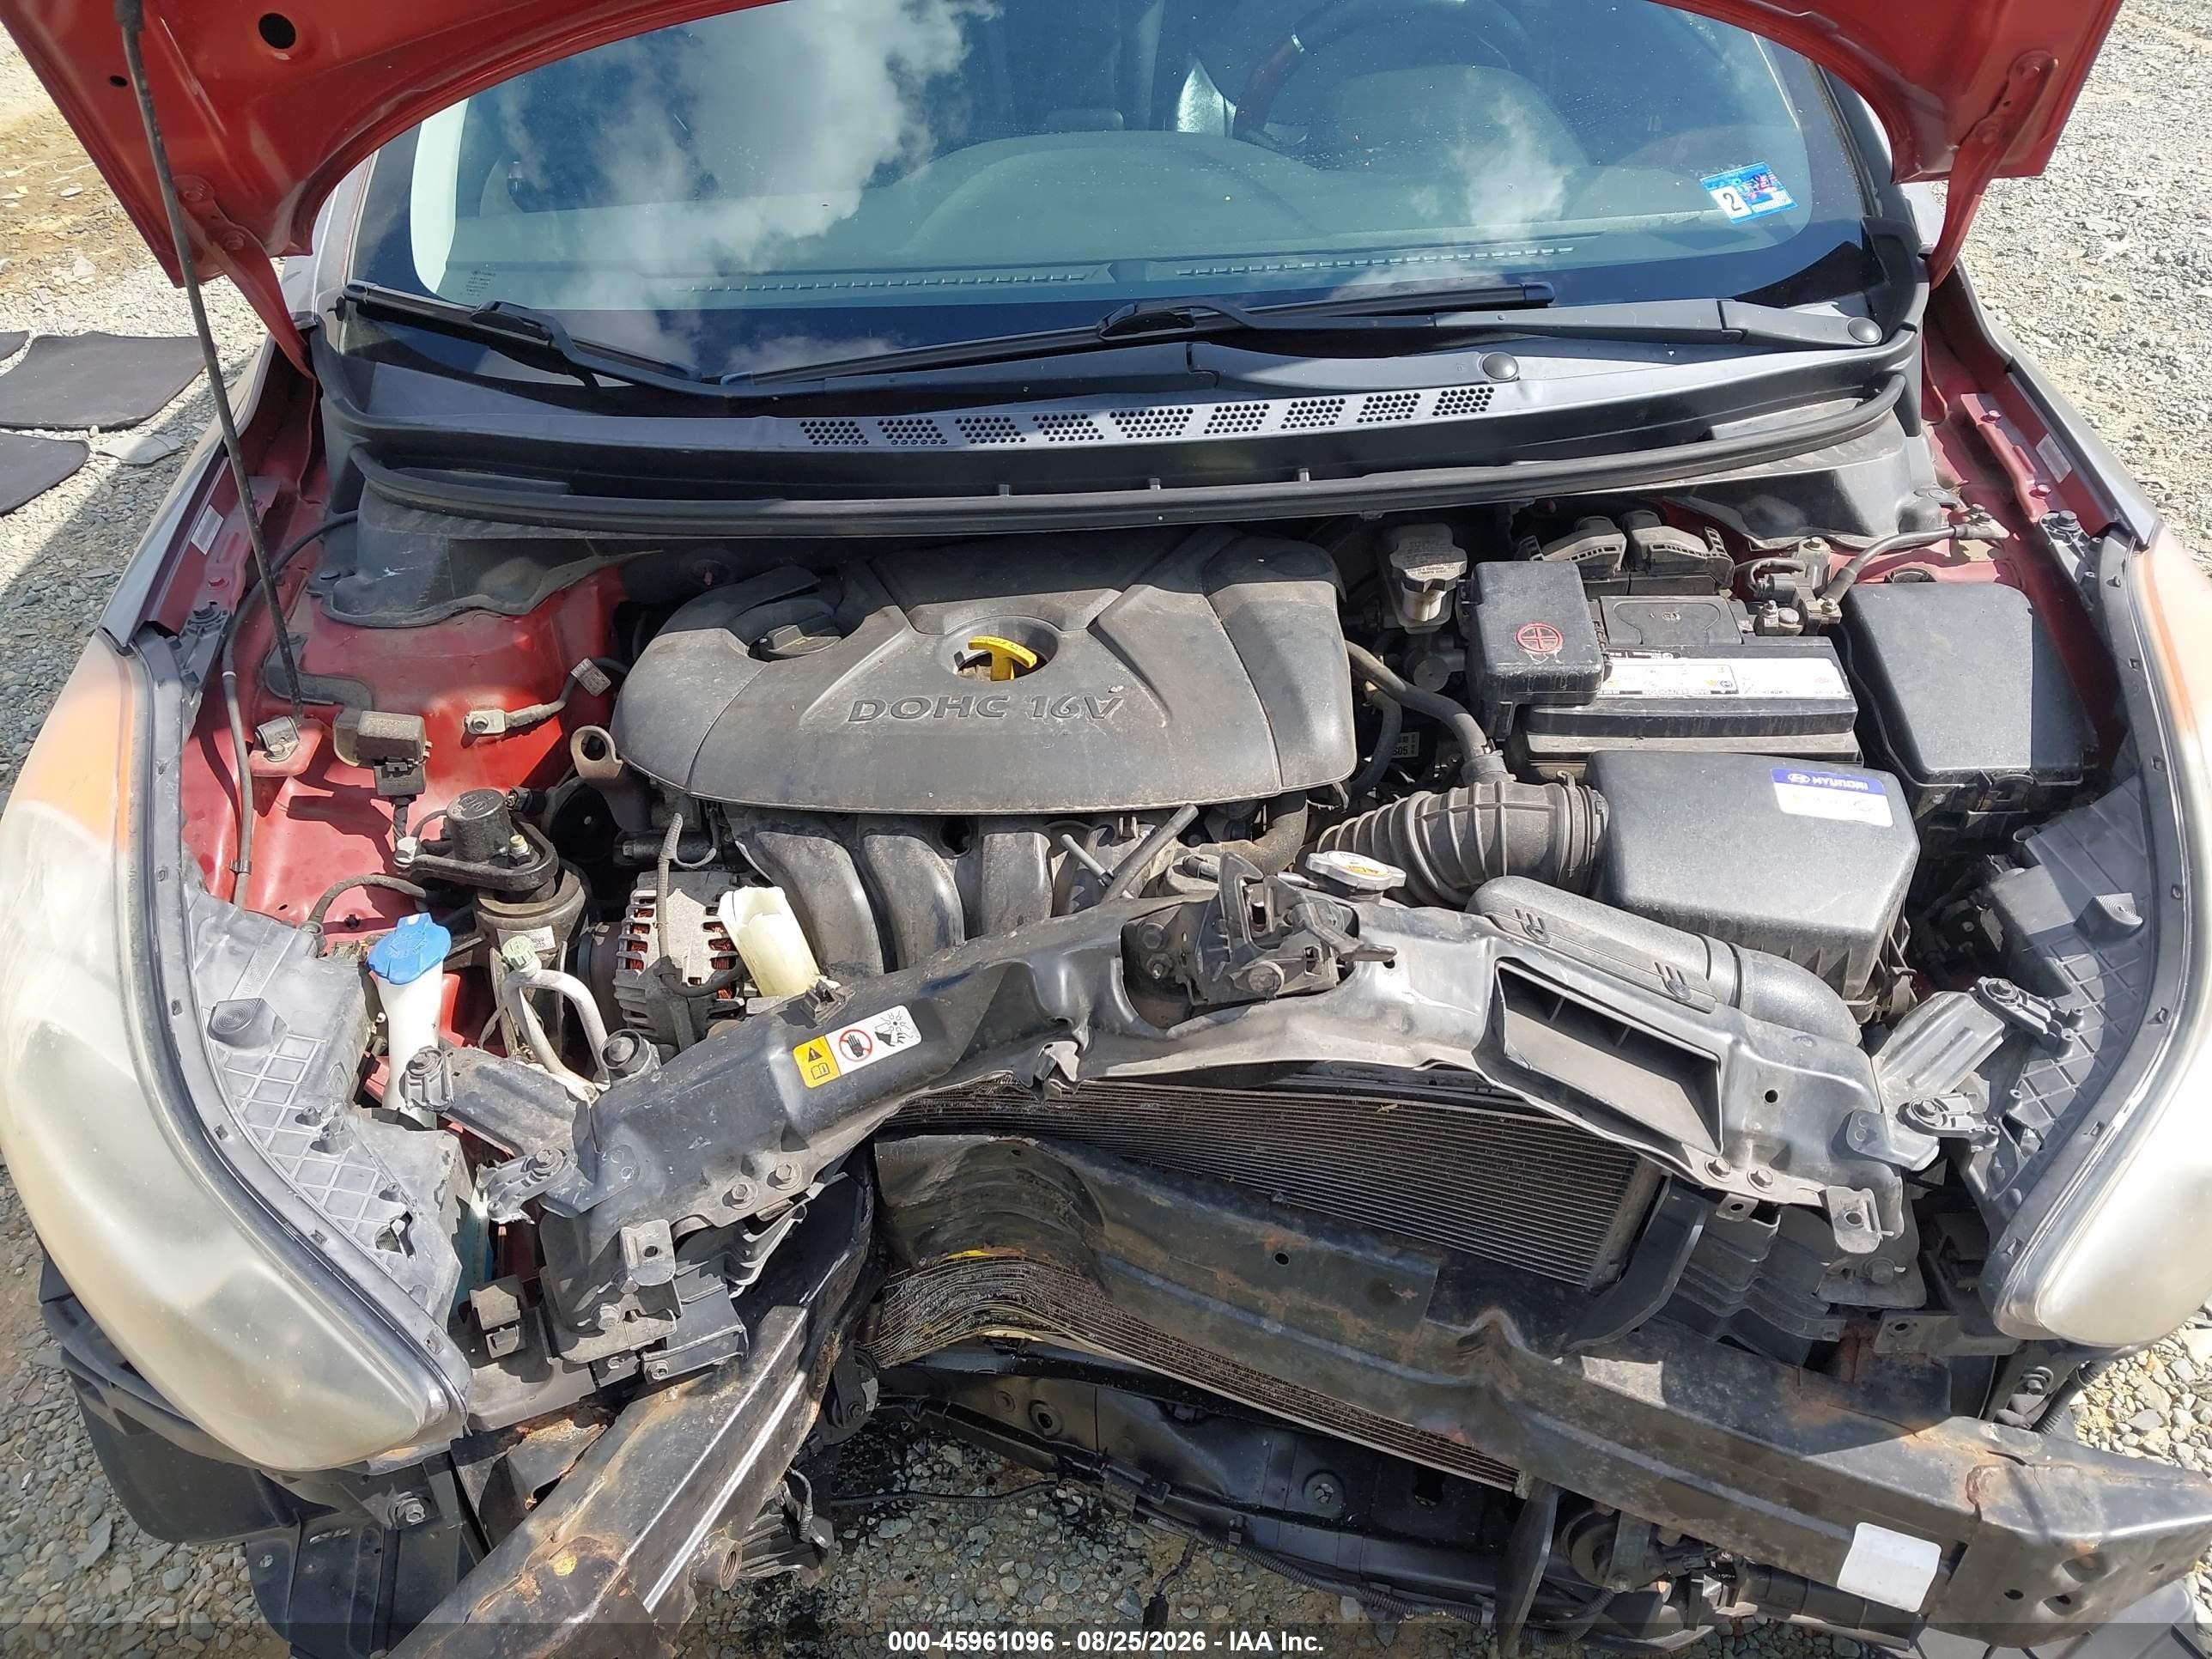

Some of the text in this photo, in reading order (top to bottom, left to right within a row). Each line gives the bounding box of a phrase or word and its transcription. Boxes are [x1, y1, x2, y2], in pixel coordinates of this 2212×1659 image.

[1723, 192, 1742, 211] 2
[848, 694, 1123, 722] DOHC 16V
[1812, 775, 1869, 791] HYUNDAI
